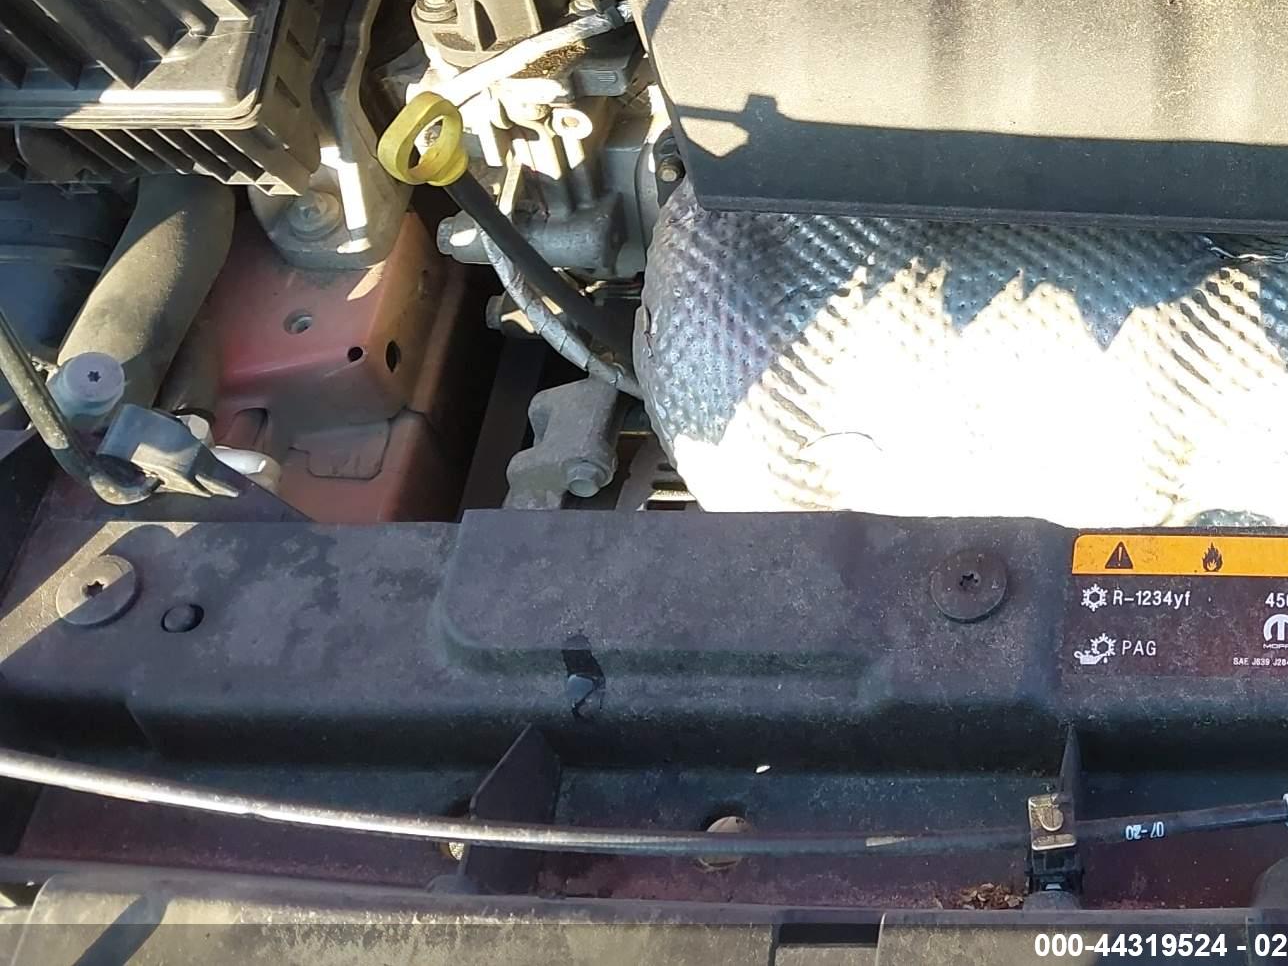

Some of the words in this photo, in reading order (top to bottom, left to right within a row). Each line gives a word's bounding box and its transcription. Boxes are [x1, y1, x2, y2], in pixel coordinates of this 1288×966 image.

[1112, 590, 1191, 610] R-1234yf
[1121, 640, 1157, 656] PAG
[1232, 657, 1249, 666] SAE
